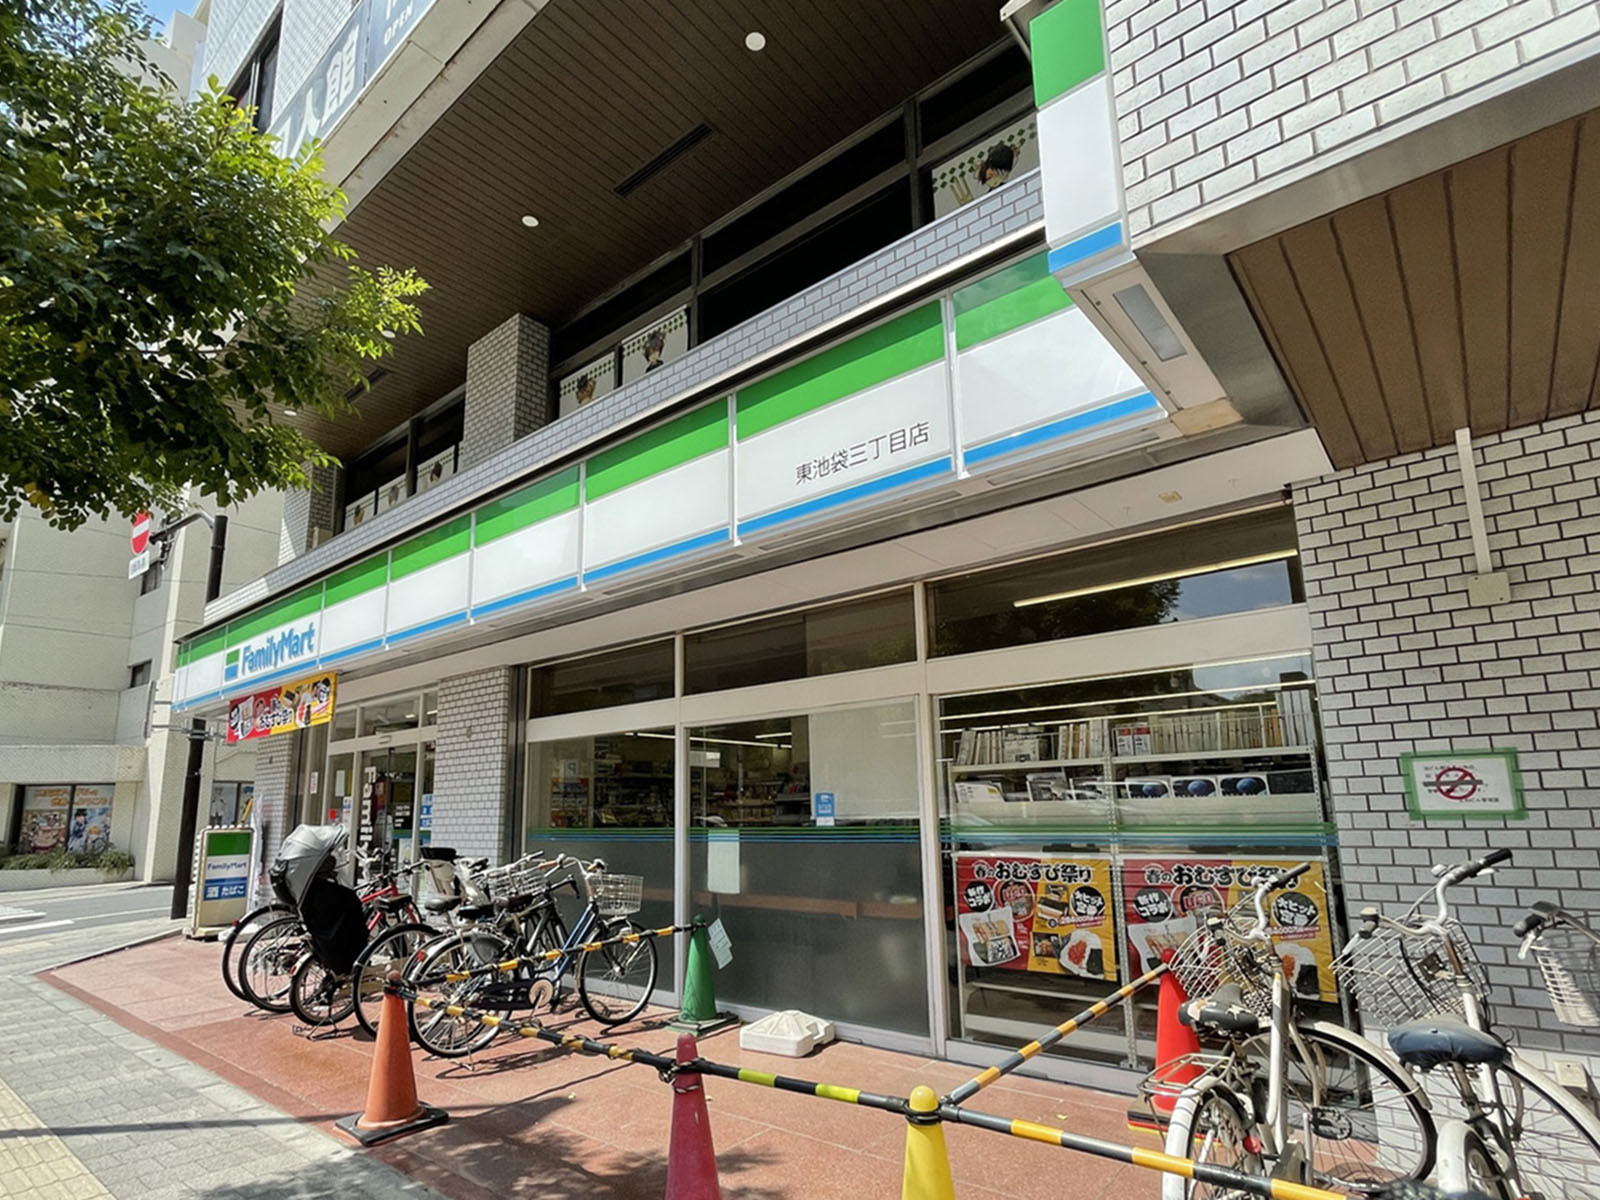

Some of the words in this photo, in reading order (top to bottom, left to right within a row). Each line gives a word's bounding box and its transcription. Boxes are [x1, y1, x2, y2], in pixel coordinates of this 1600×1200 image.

[795, 421, 929, 486] 東池袋三丁目店
[241, 621, 315, 676] FamilyMart
[207, 861, 247, 872] FamilyMart
[967, 892, 992, 907] コラボ
[1138, 900, 1171, 917] コラボ
[1276, 896, 1317, 916] 大ヒット
